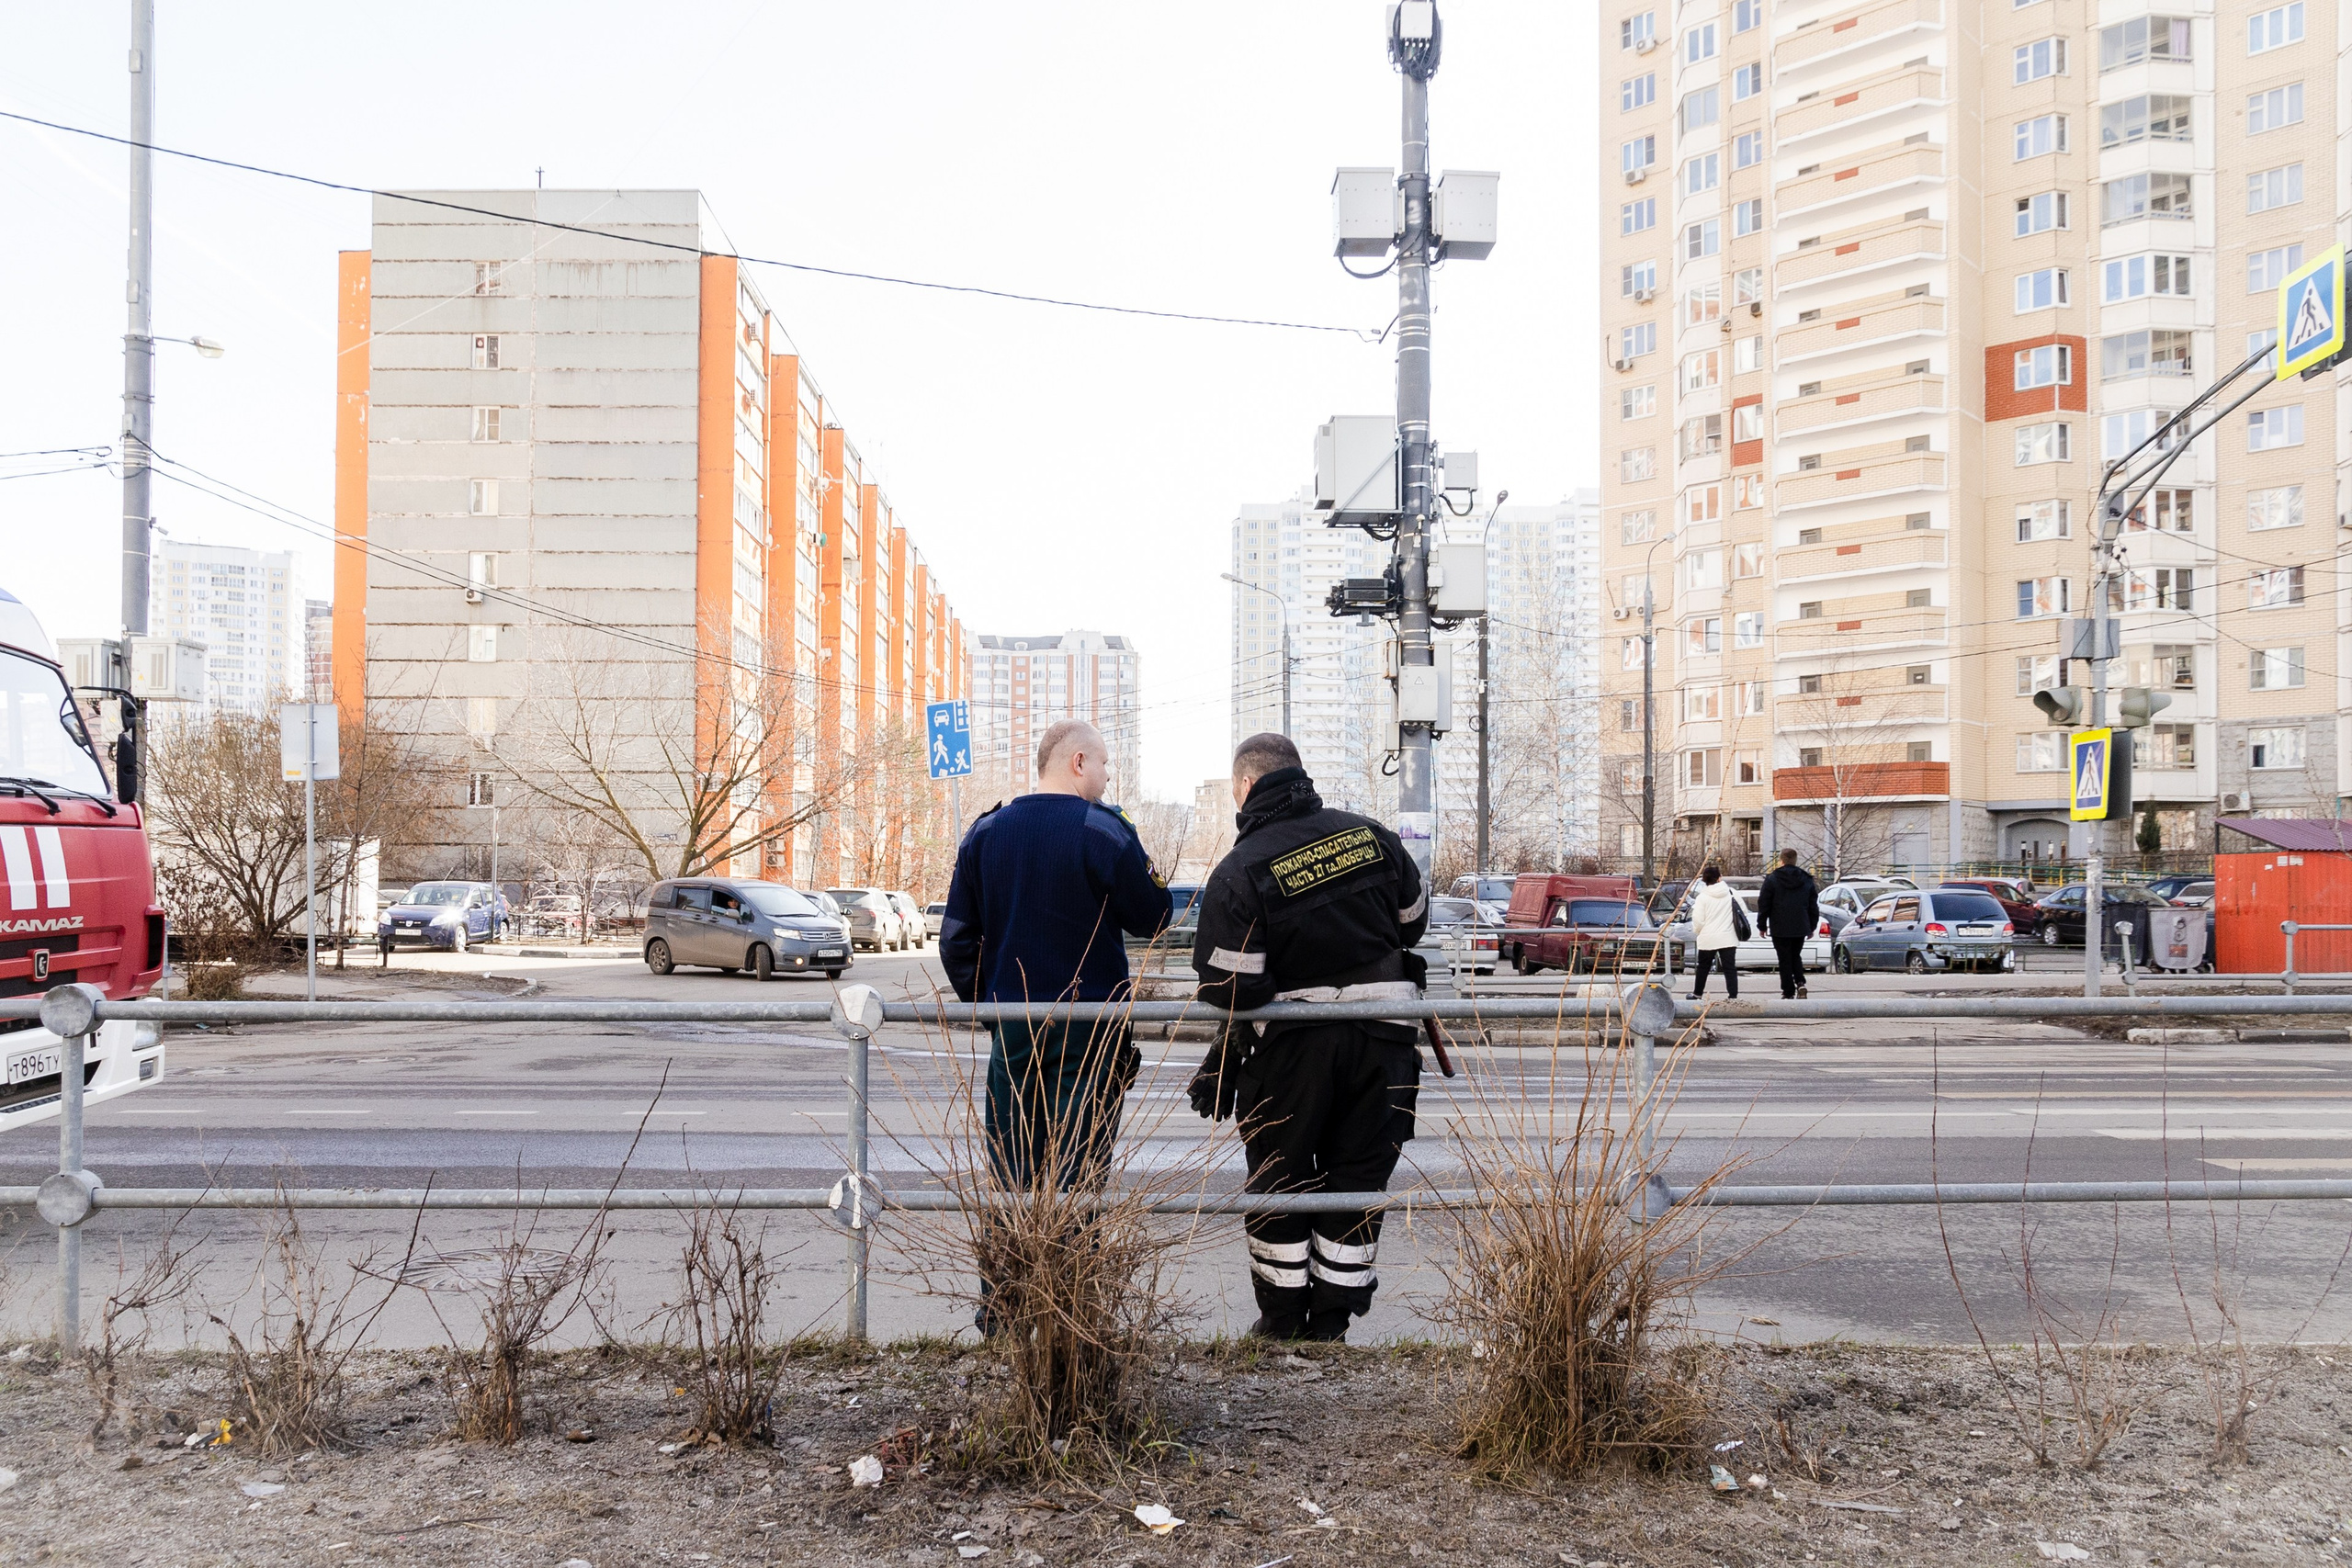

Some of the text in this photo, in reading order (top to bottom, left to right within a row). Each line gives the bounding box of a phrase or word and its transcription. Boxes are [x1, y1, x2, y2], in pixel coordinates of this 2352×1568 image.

[1273, 829, 1374, 877] ПОЖАРНО-СПАСАТЕЛЬНАЯ
[1285, 869, 1315, 889] ЧАСТЬ
[1313, 863, 1325, 878] 27
[0, 916, 84, 932] KAMAZ
